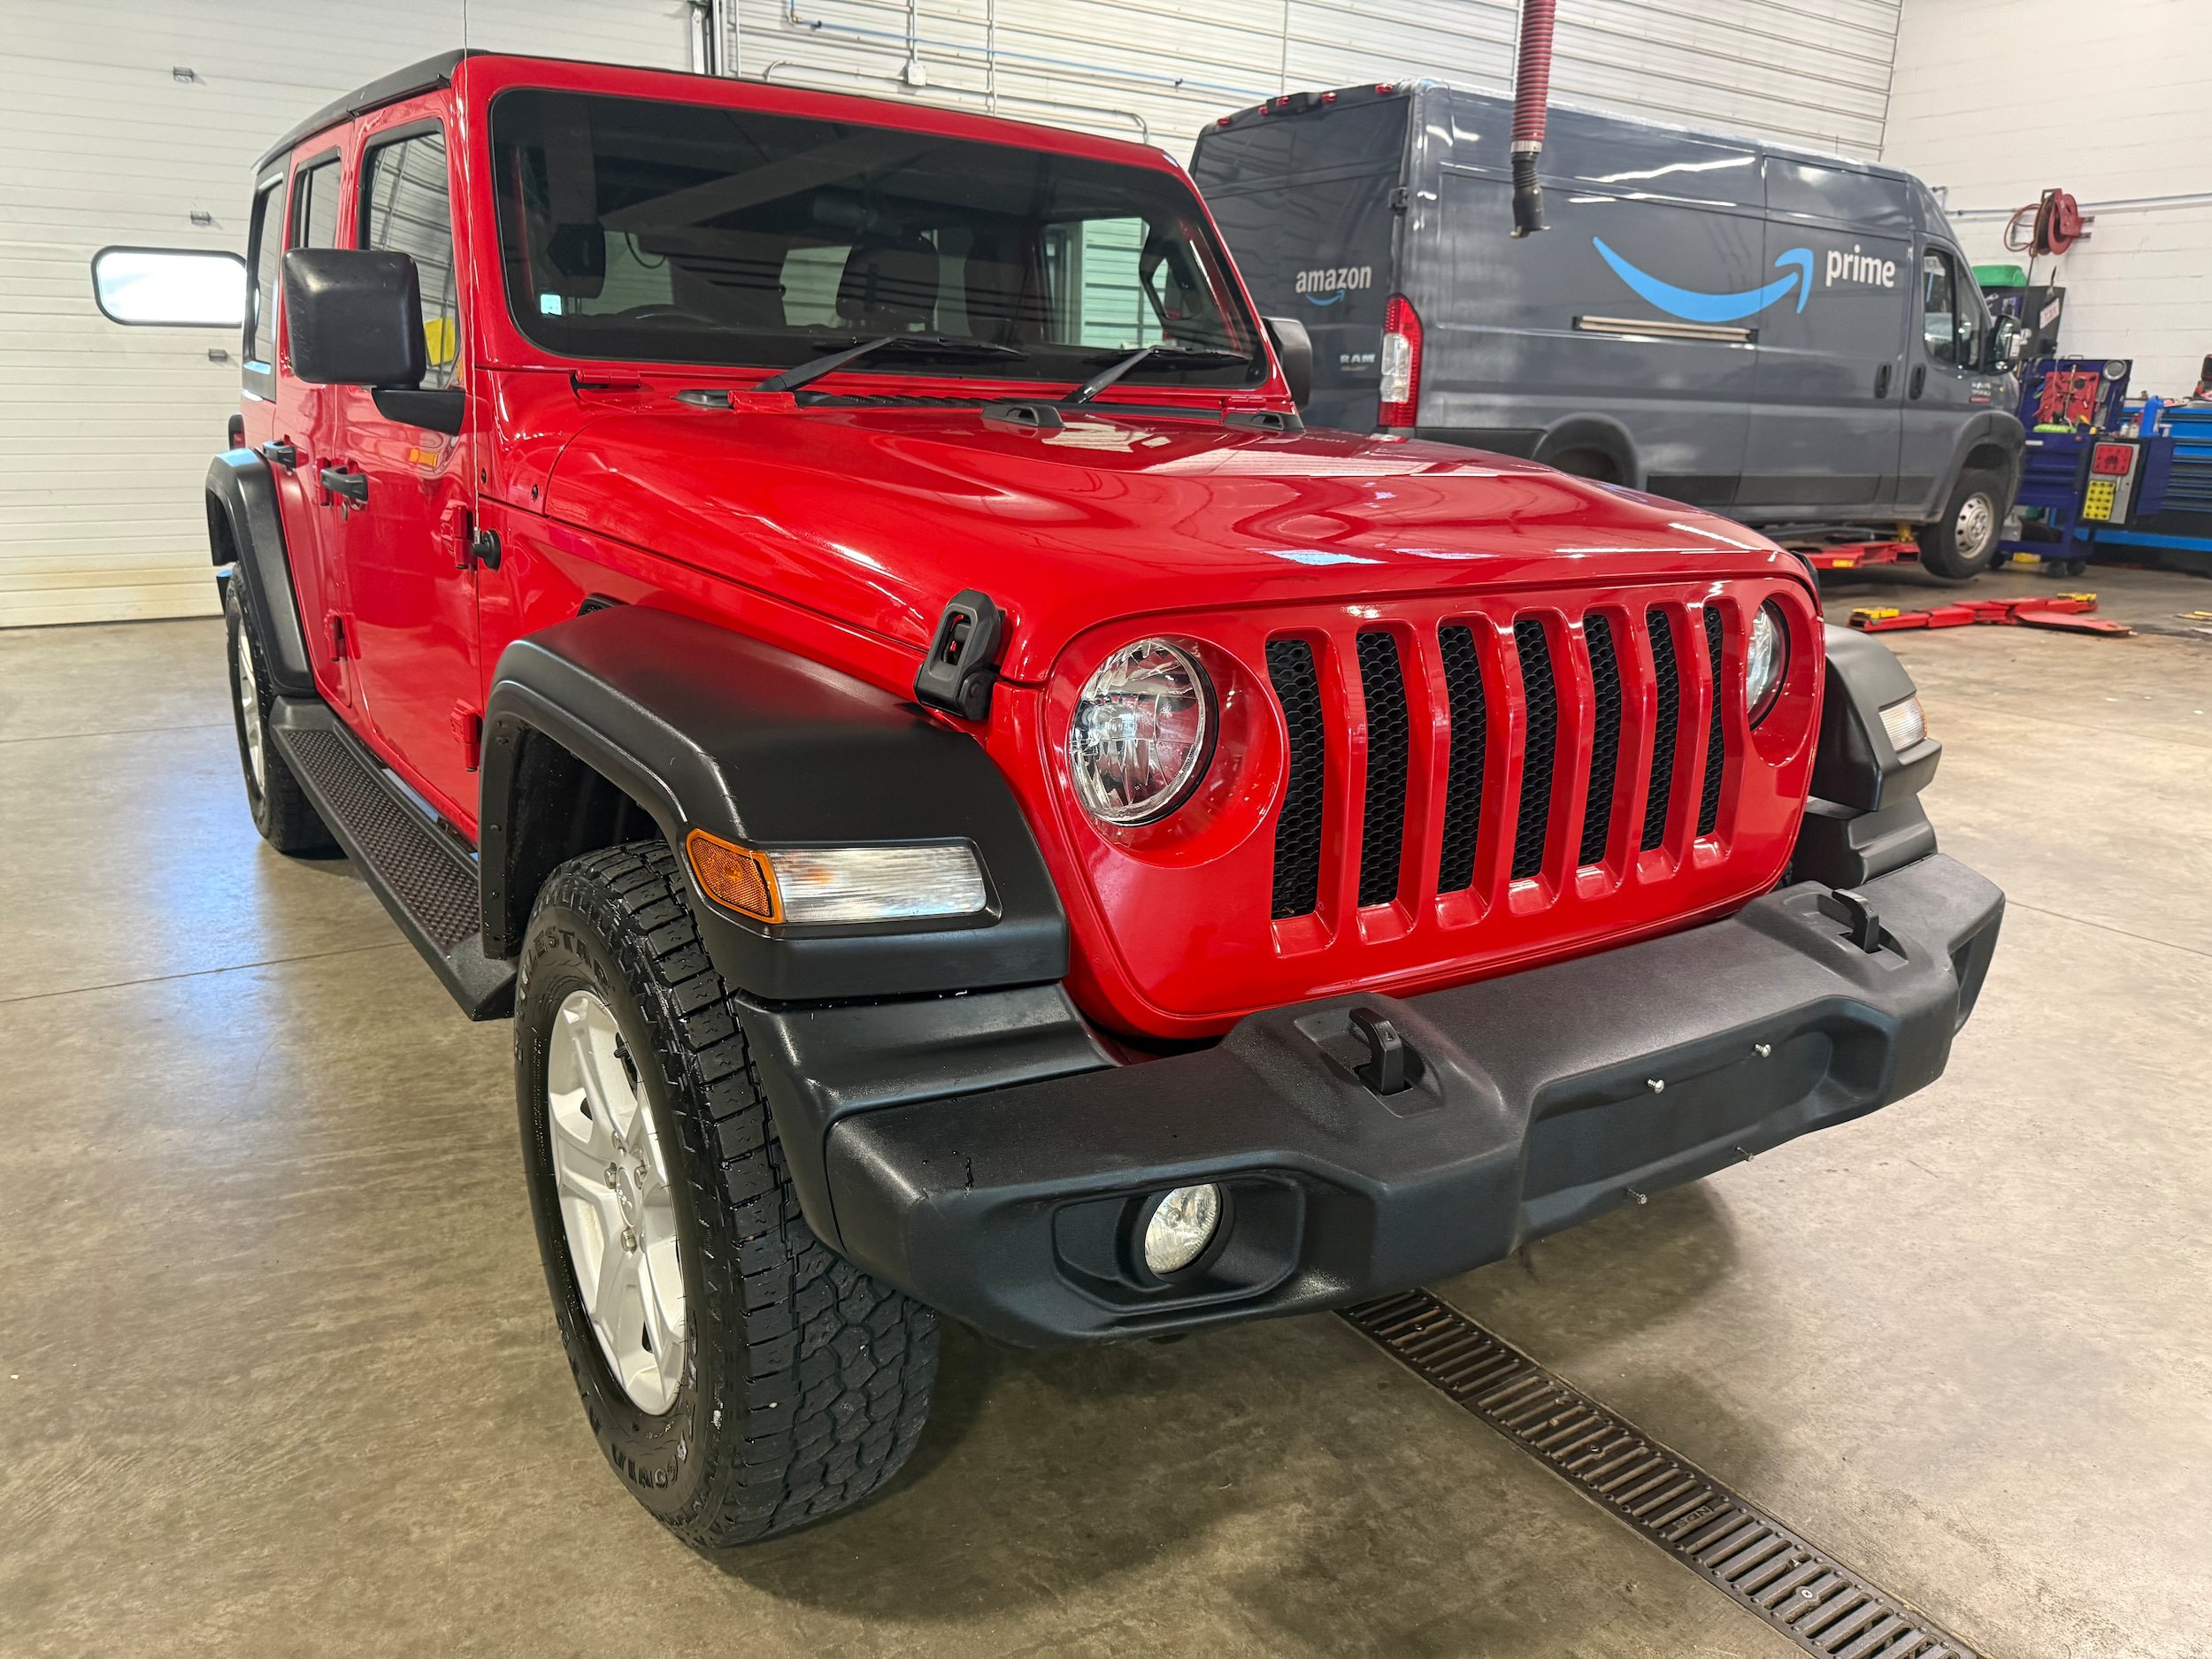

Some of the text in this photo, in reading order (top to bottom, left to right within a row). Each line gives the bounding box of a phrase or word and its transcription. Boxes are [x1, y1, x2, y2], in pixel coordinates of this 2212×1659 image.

[1825, 244, 1895, 288] prime
[1295, 266, 1372, 293] amazon
[1340, 354, 1375, 364] RAM
[1671, 1506, 1714, 1528] NDS
